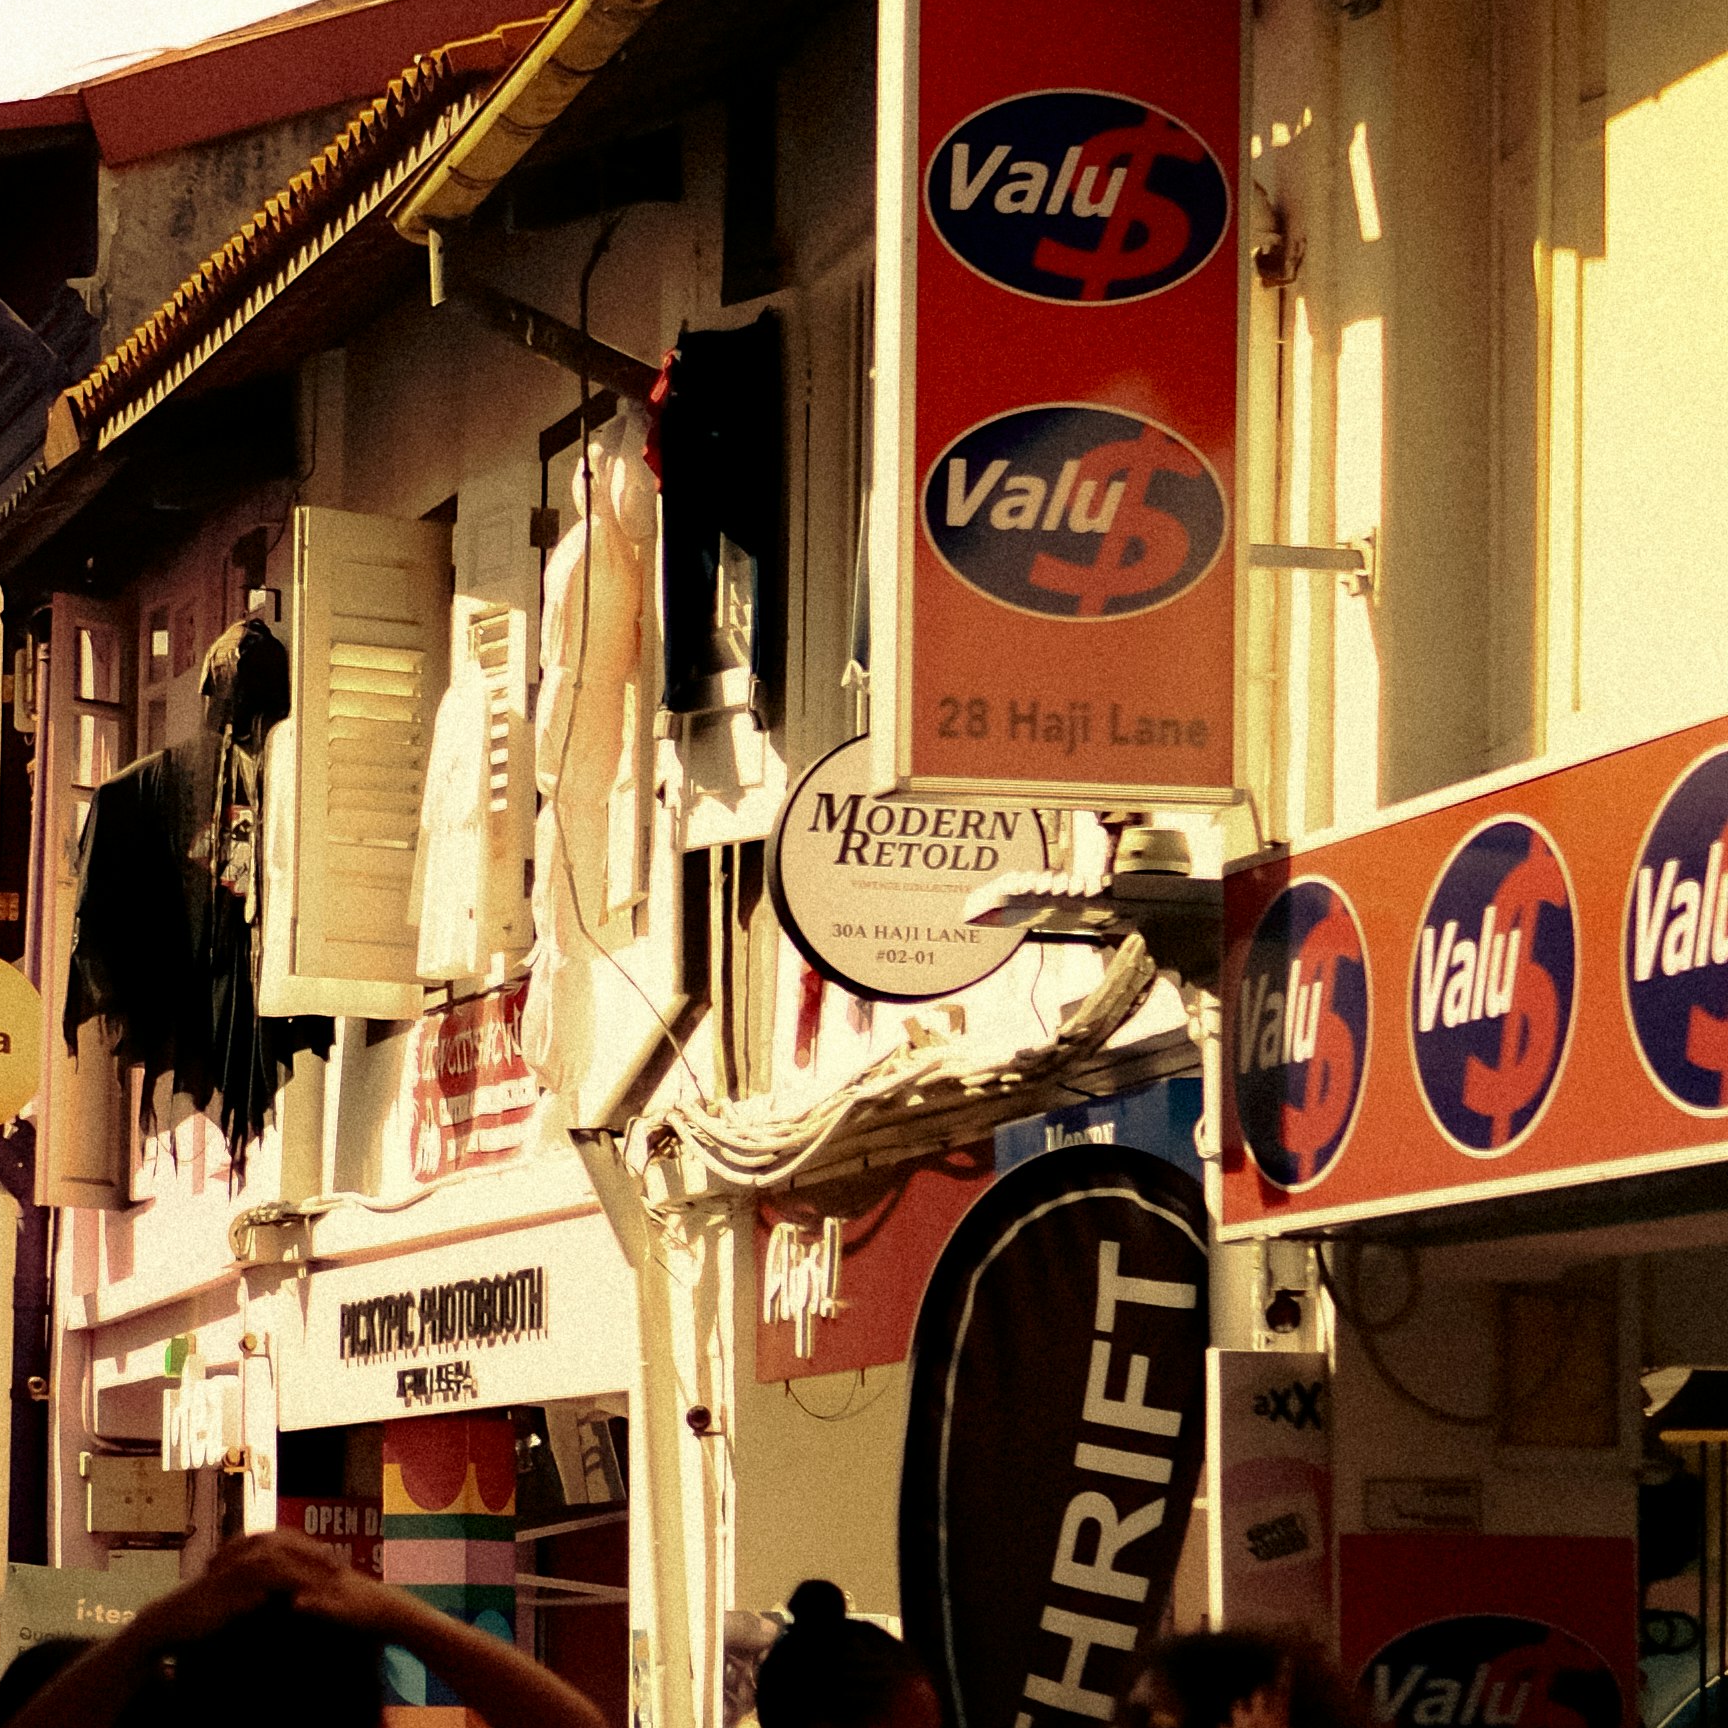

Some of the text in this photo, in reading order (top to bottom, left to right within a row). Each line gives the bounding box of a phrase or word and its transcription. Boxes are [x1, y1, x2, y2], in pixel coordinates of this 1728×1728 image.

[938, 696, 1208, 757] 28 Haji Lane
[808, 792, 1021, 841] MODERN
[833, 829, 1000, 872] RETOLD
[832, 923, 980, 944] 30A HAJI LANE
[875, 949, 935, 965] #02-01
[304, 1504, 358, 1536] OPEN
